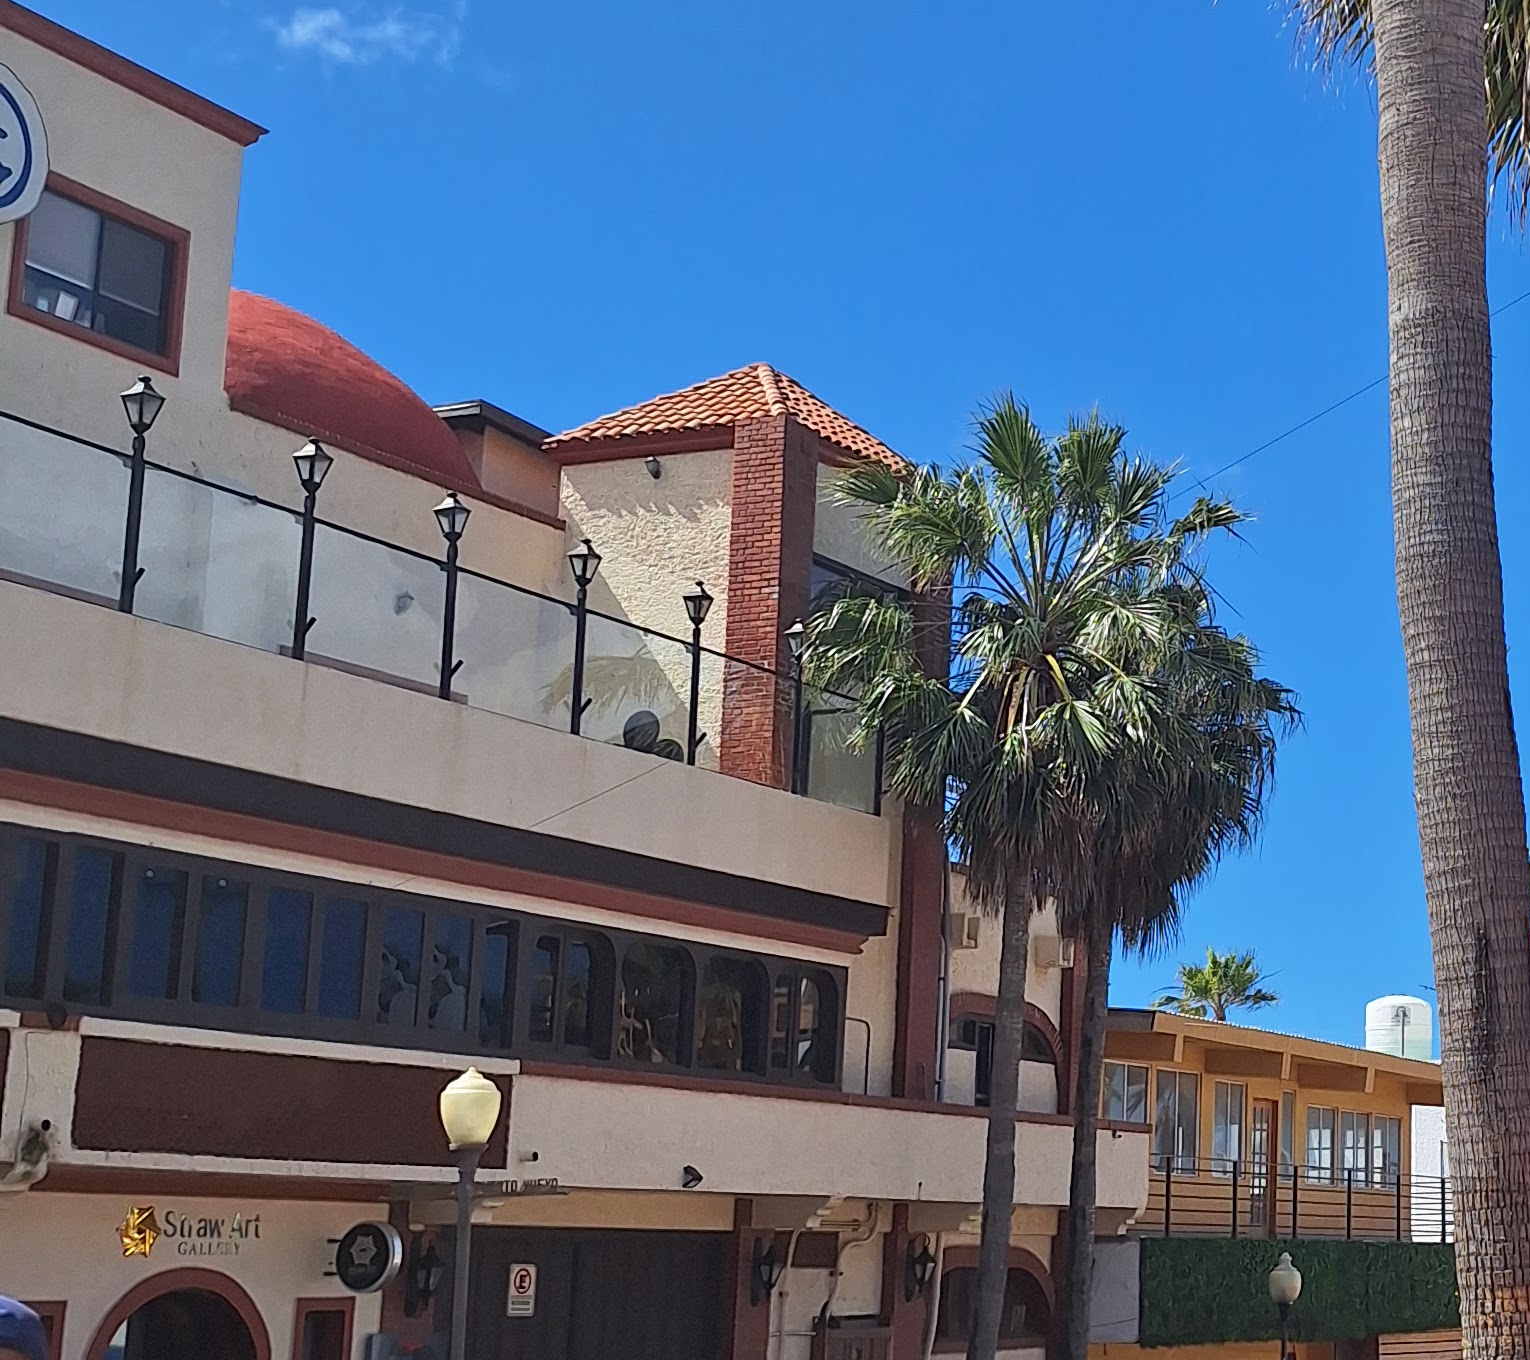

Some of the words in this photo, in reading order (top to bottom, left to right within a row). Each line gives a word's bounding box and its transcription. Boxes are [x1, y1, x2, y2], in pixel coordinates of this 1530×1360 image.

[163, 1210, 225, 1239] Straw
[228, 1211, 261, 1239] Art
[177, 1241, 241, 1256] GALLERY
